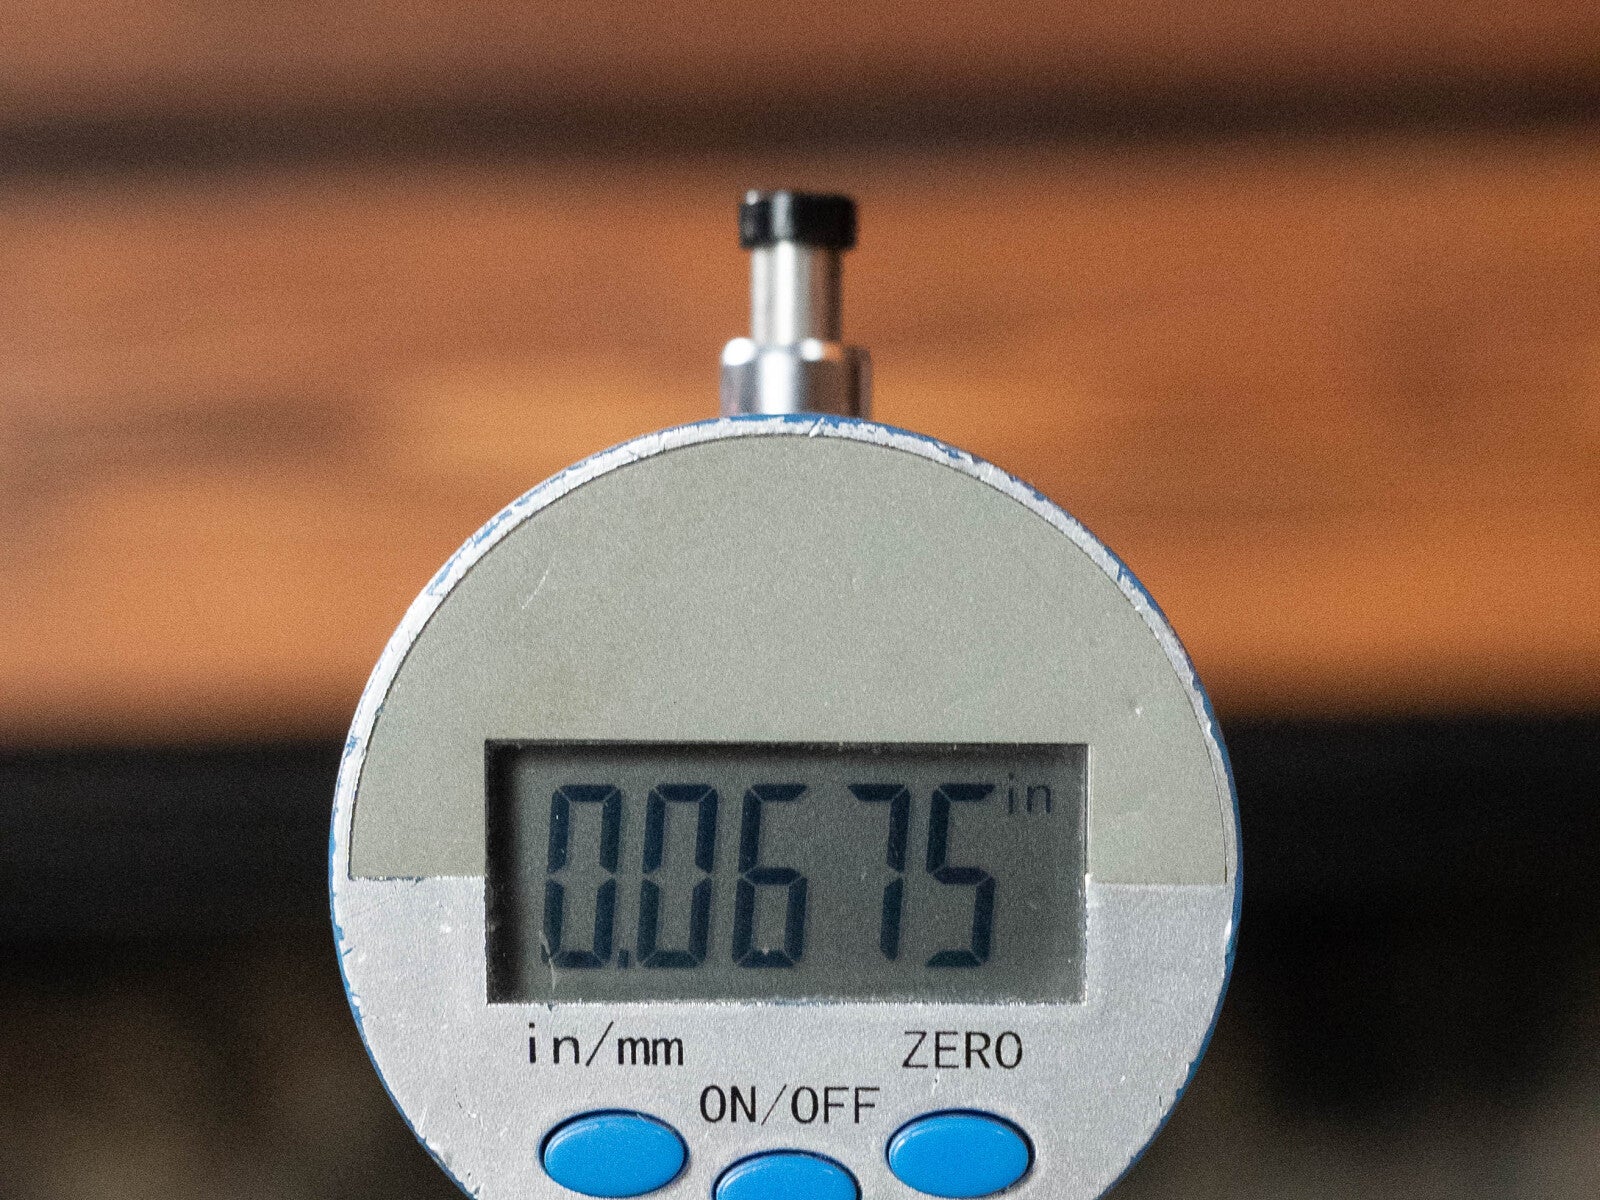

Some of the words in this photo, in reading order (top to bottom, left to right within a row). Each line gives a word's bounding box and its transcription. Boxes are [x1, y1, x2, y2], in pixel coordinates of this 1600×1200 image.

[1008, 773, 1052, 814] in
[528, 1021, 685, 1067] in/mm
[902, 1030, 1023, 1070] ZERO
[699, 1084, 881, 1126] ON/OFF
